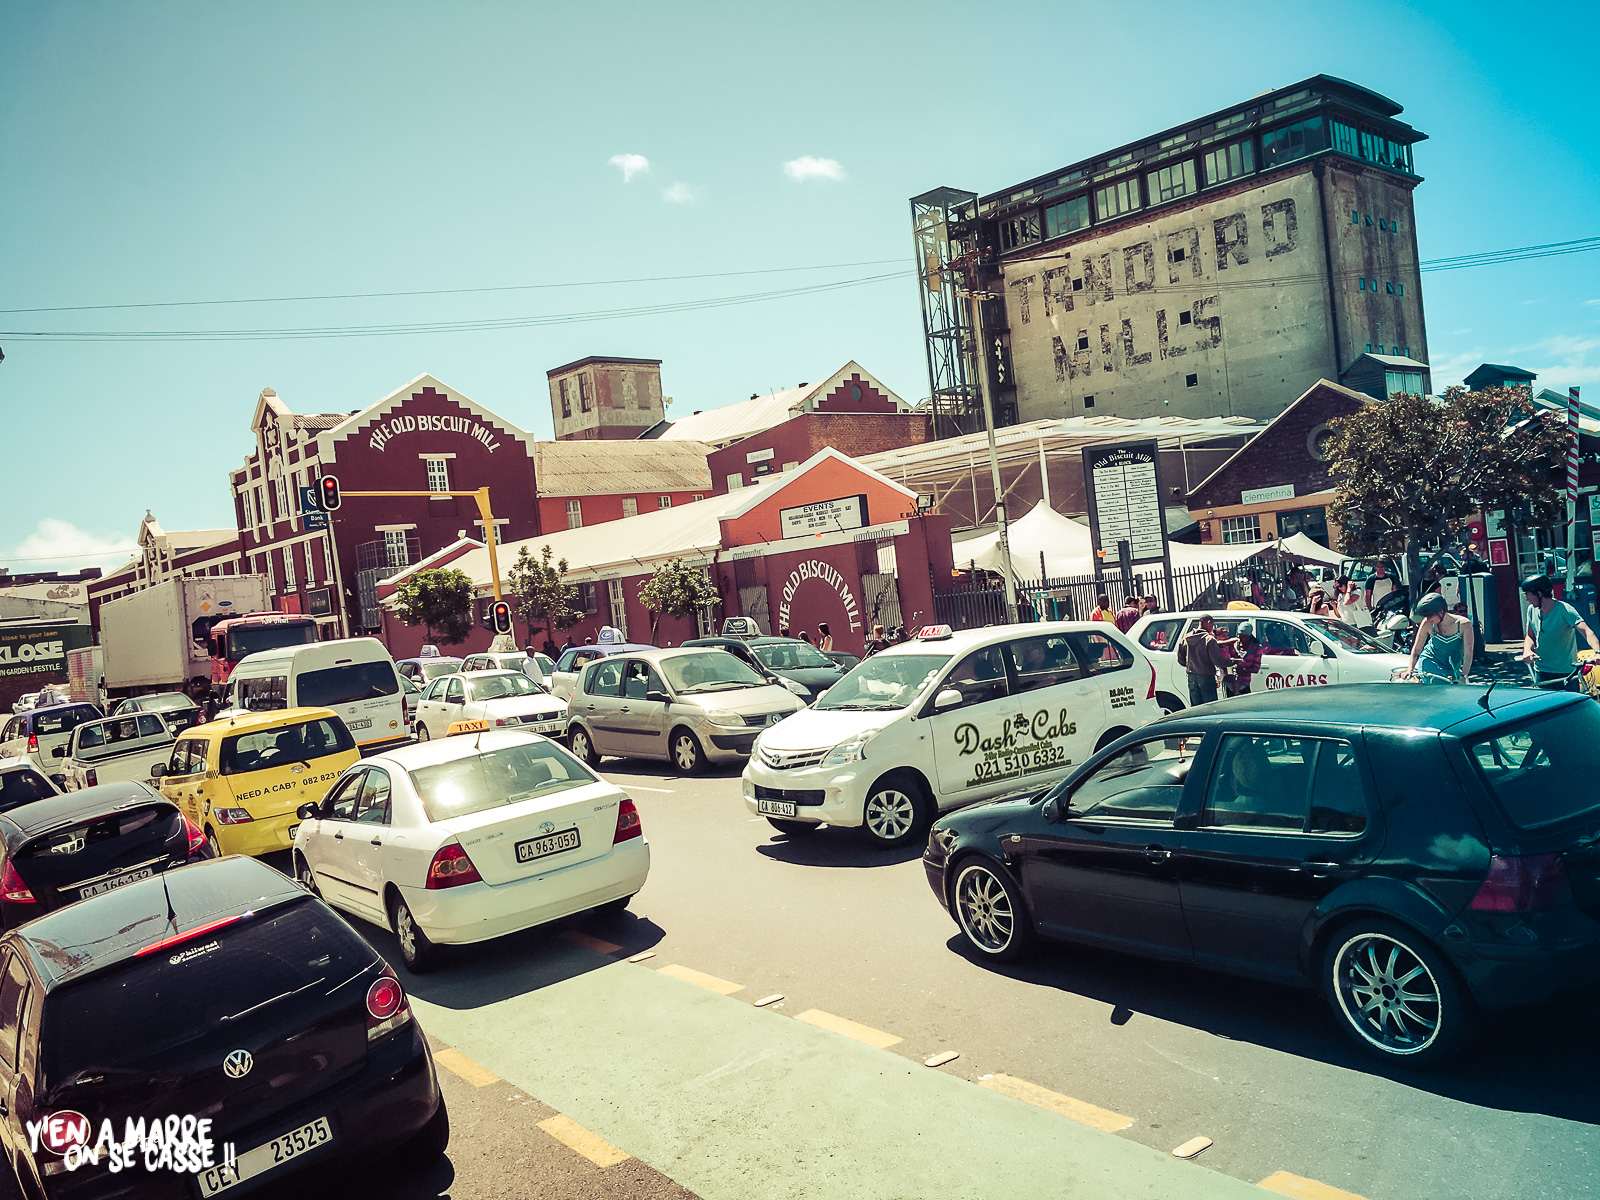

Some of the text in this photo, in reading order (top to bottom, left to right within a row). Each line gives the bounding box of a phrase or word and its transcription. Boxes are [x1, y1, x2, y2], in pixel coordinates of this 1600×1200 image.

[1052, 294, 1222, 382] MILLS
[370, 415, 501, 454] THE OLD BISCUIT MILL
[1094, 452, 1152, 469] Old Biscuit Mill
[1244, 490, 1292, 502] clementina
[803, 502, 834, 513] EVENTS
[782, 570, 800, 602] OLD
[798, 560, 844, 591] BISCUIT
[840, 583, 861, 633] MILL
[920, 626, 944, 636] TAXI
[1156, 631, 1165, 640] 10
[6, 666, 30, 676] GARDEN
[457, 722, 484, 732] TAXI
[954, 708, 1077, 756] Dash Cabs
[975, 746, 1065, 778] 021 510 6332
[236, 789, 261, 801] NEED
[272, 782, 296, 792] CAB?
[302, 777, 318, 786] 082
[320, 772, 335, 781] 823
[762, 801, 768, 811] CA
[519, 832, 576, 859] CA 963-059
[83, 887, 98, 898] CA
[204, 1120, 328, 1193] CEY 23525
